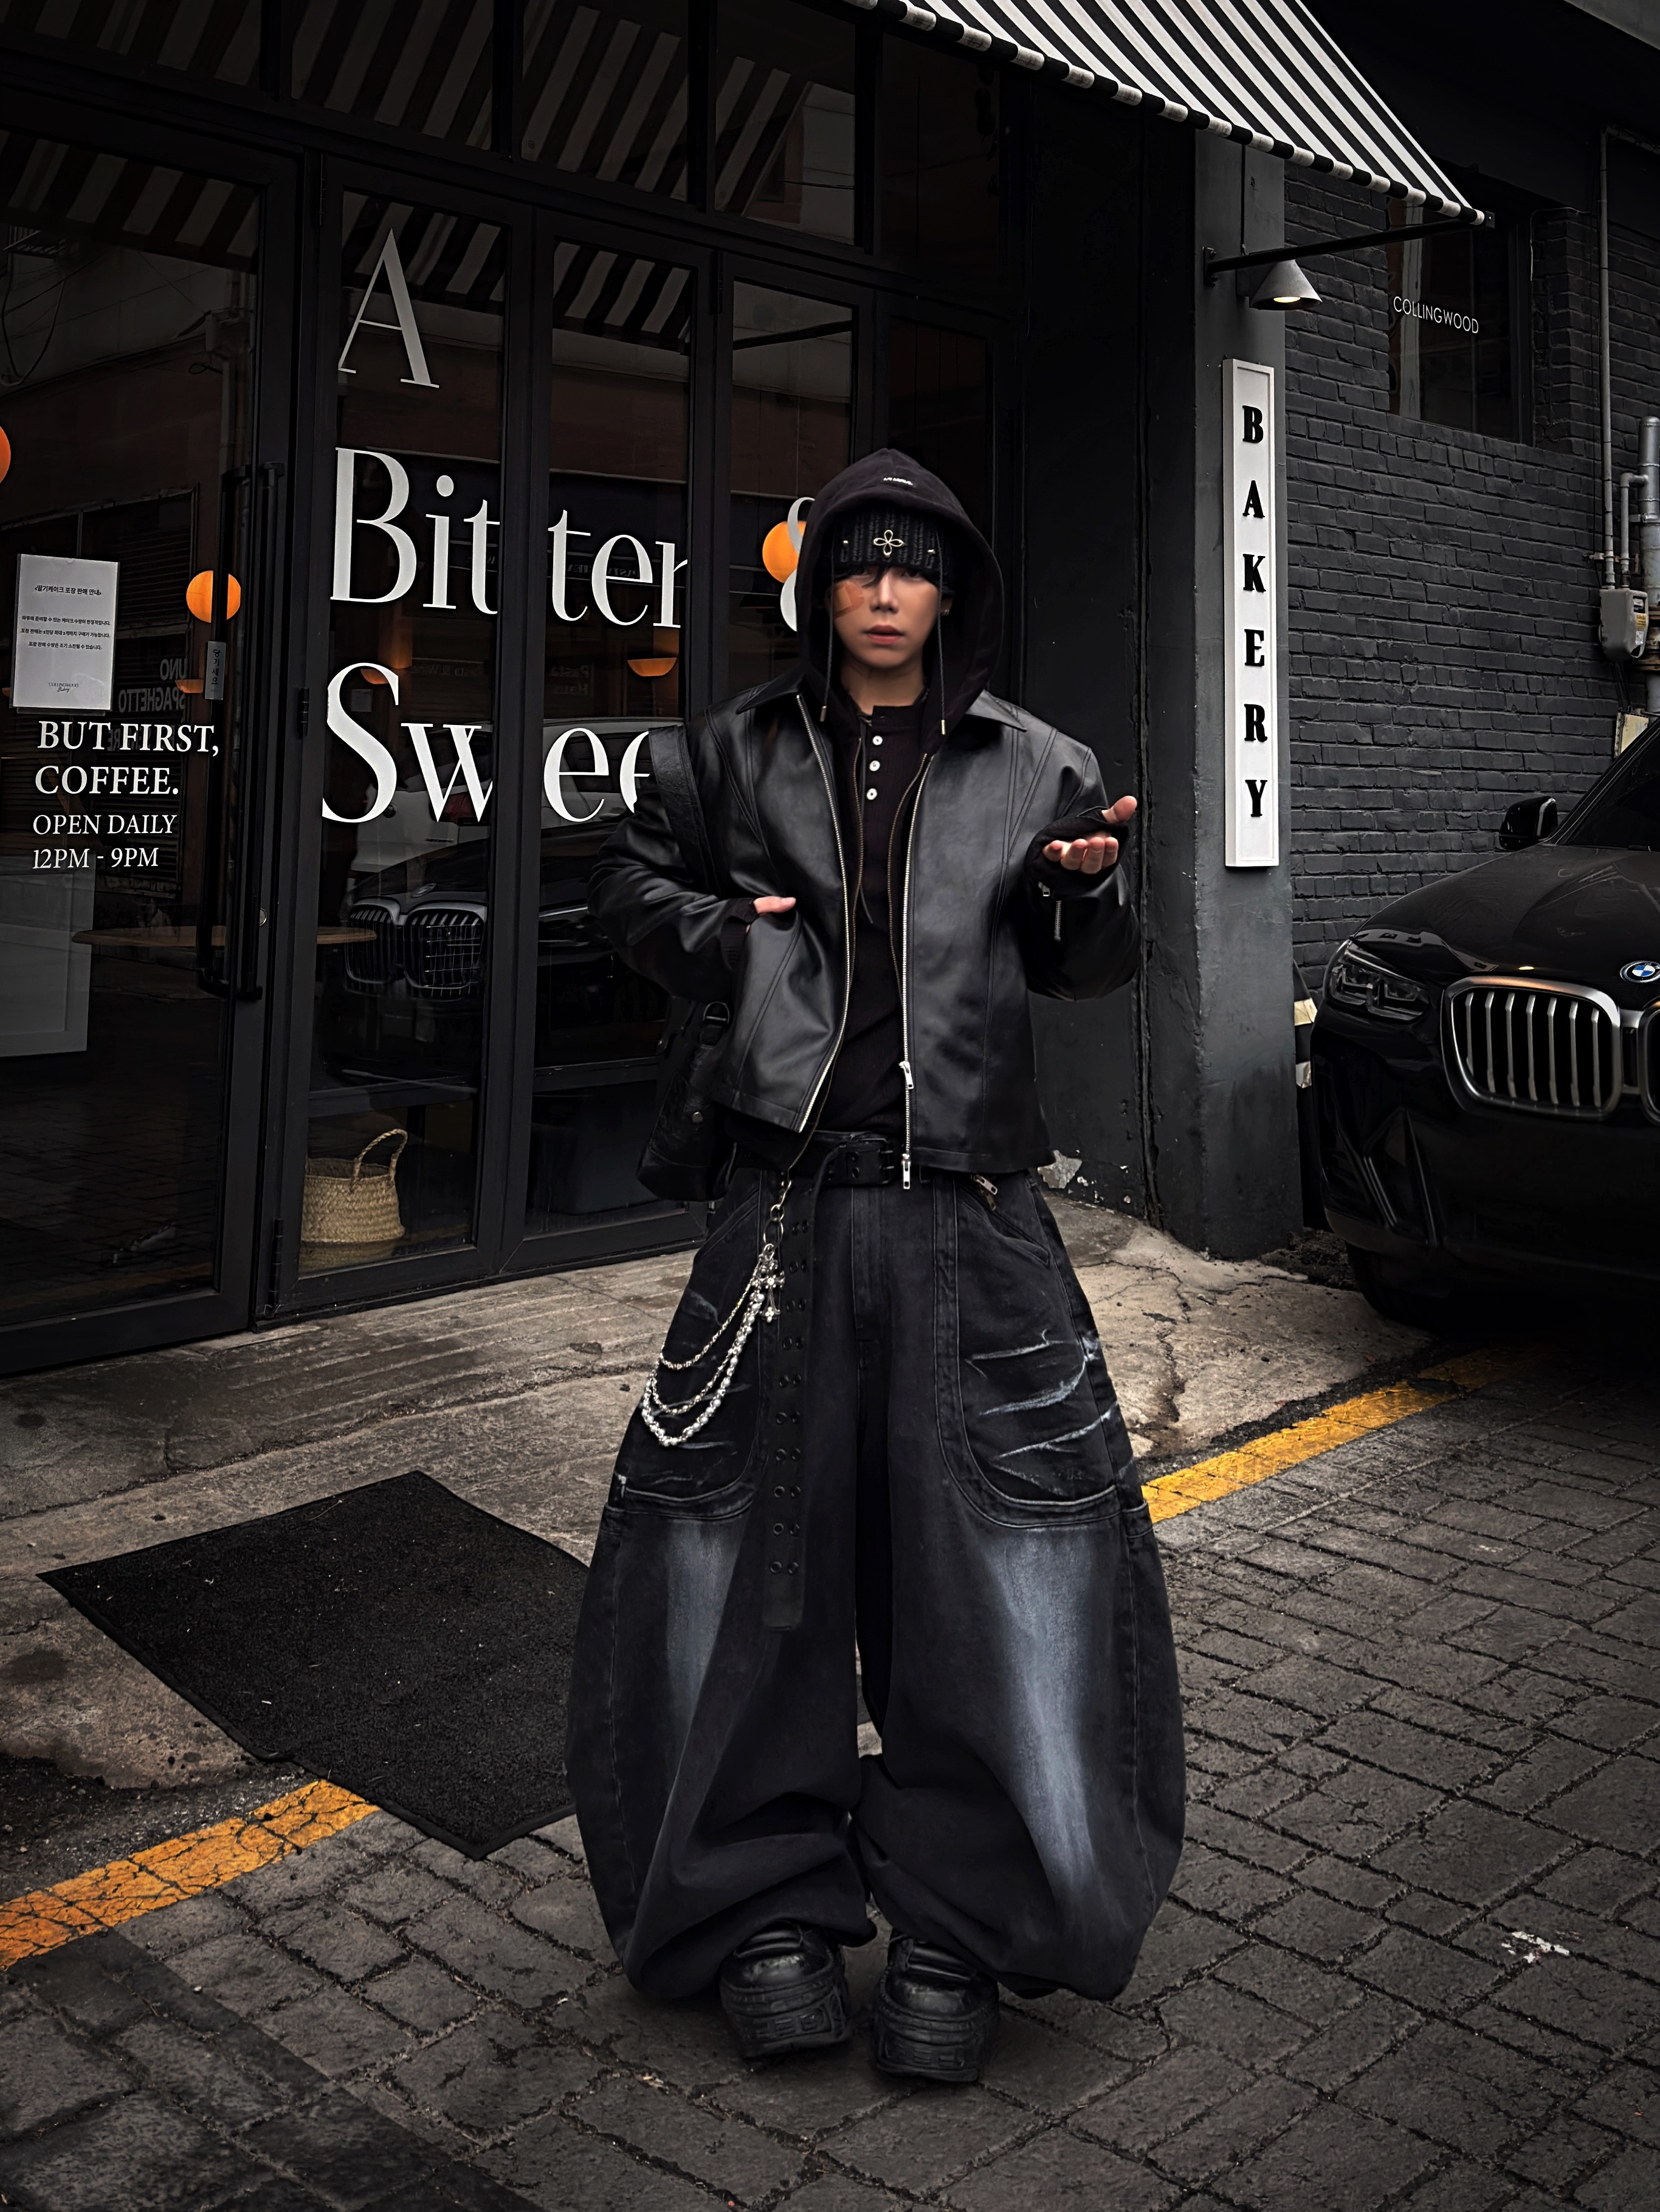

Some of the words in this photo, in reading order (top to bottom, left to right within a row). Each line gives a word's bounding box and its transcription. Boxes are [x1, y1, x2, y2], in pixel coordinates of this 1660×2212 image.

[338, 228, 439, 388] A
[1393, 296, 1479, 334] COLLINGWOOD
[1242, 405, 1268, 817] BAKERY
[212, 650, 220, 685] 당기세요
[37, 721, 111, 749] BUT
[120, 723, 219, 757] FIRST,
[35, 766, 179, 794] COFFEE.
[33, 815, 102, 834] OPEN
[107, 815, 177, 834] DAILY
[33, 848, 90, 868] 12PM
[111, 847, 159, 868] 9PM
